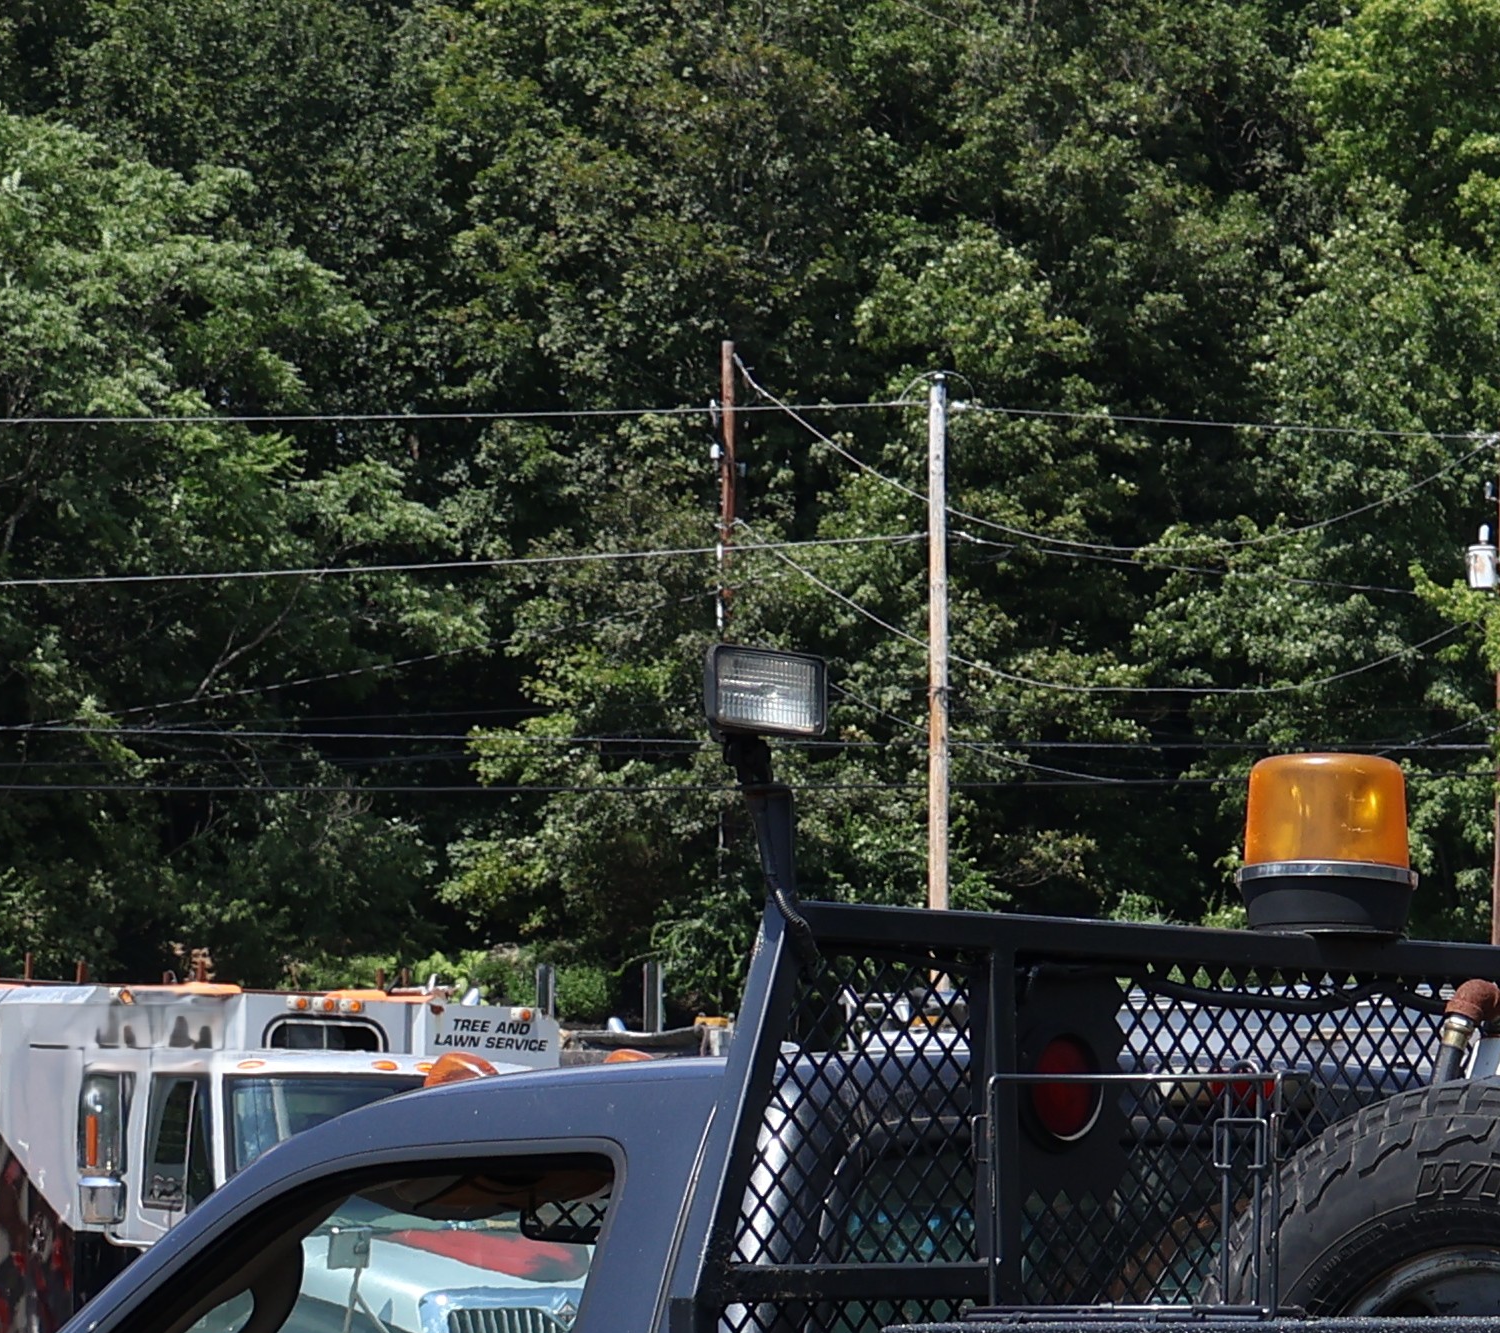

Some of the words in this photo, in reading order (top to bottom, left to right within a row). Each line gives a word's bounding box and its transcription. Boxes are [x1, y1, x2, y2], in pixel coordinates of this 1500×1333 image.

[452, 1018, 491, 1033] TREE
[494, 1021, 531, 1036] AND
[433, 1033, 481, 1048] LAWN
[484, 1036, 549, 1052] SERVICE
